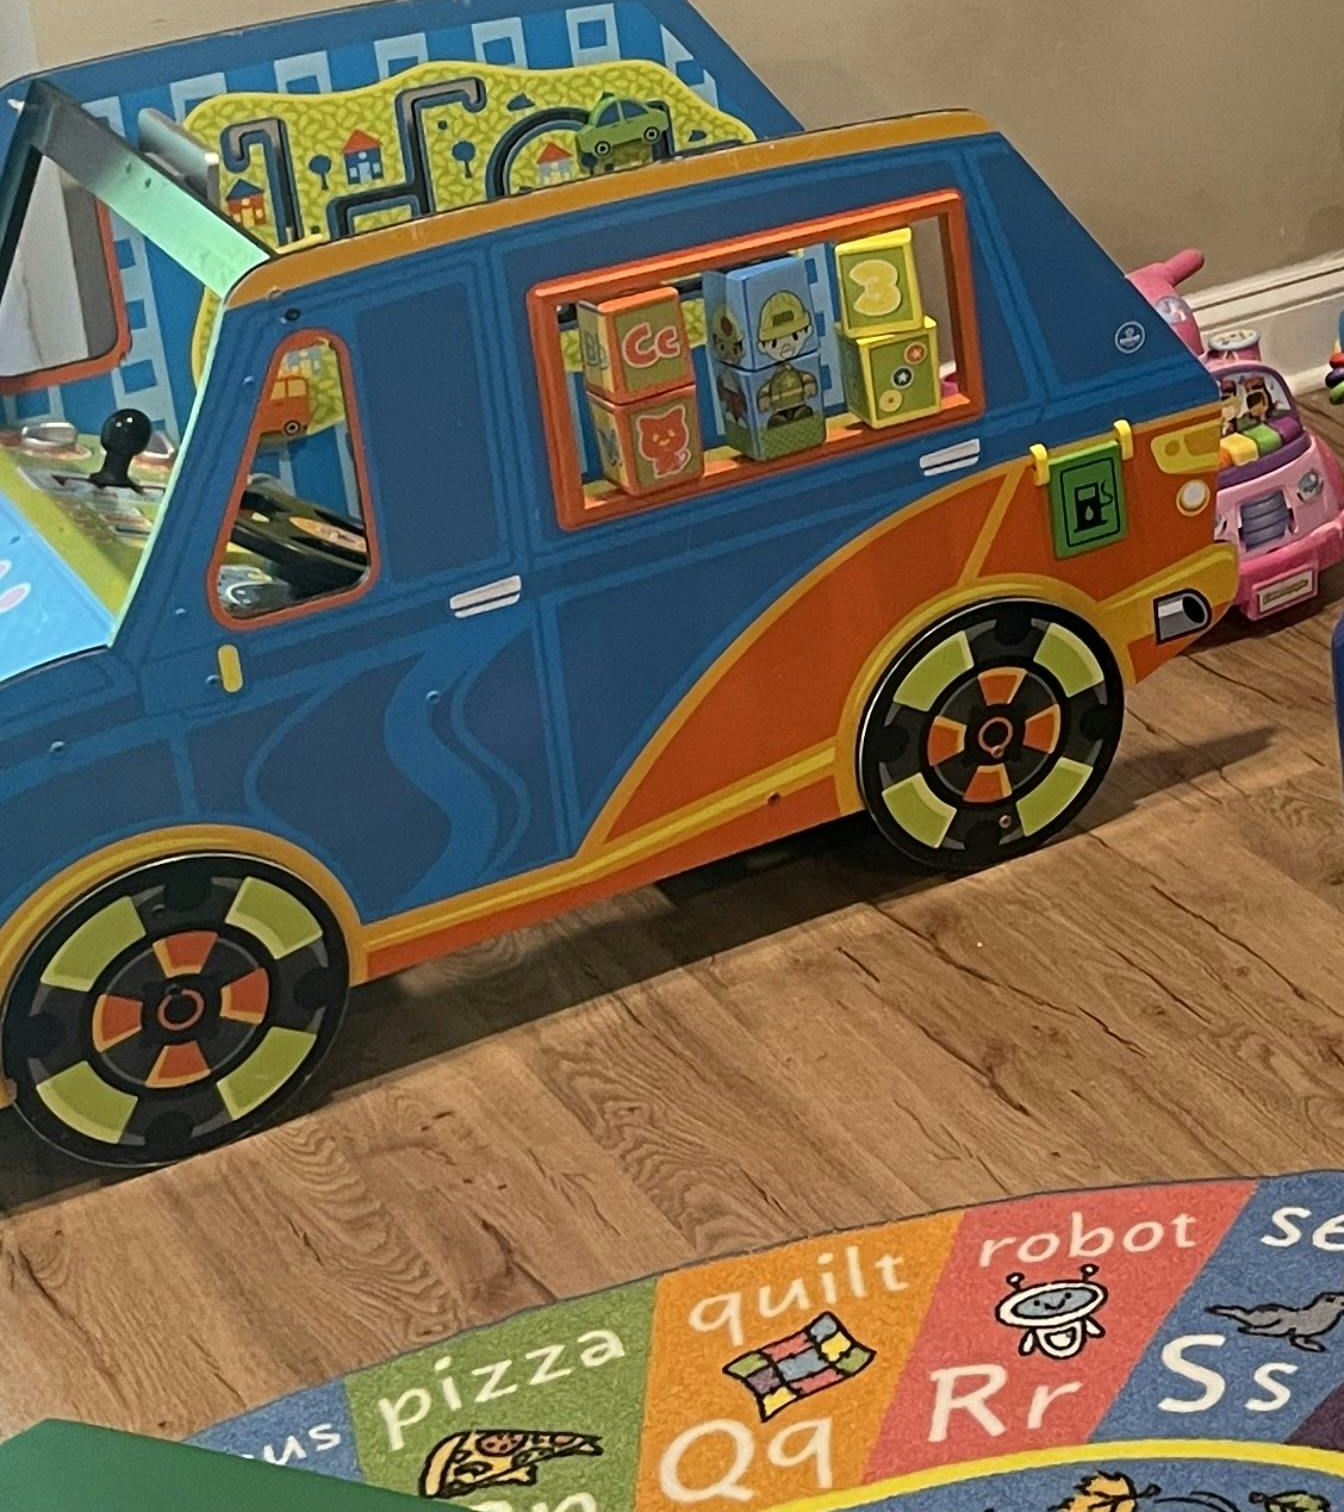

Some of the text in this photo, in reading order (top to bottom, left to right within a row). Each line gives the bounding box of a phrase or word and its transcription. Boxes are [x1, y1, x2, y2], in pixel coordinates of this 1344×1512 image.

[848, 258, 902, 317] 3
[621, 321, 681, 369] Cc
[978, 1211, 1198, 1268] robot
[688, 1245, 908, 1346] quilt
[377, 1327, 626, 1451] pizza
[928, 1362, 1083, 1444] Rr
[1157, 1334, 1299, 1414] Ss
[658, 1414, 834, 1506] Qq
